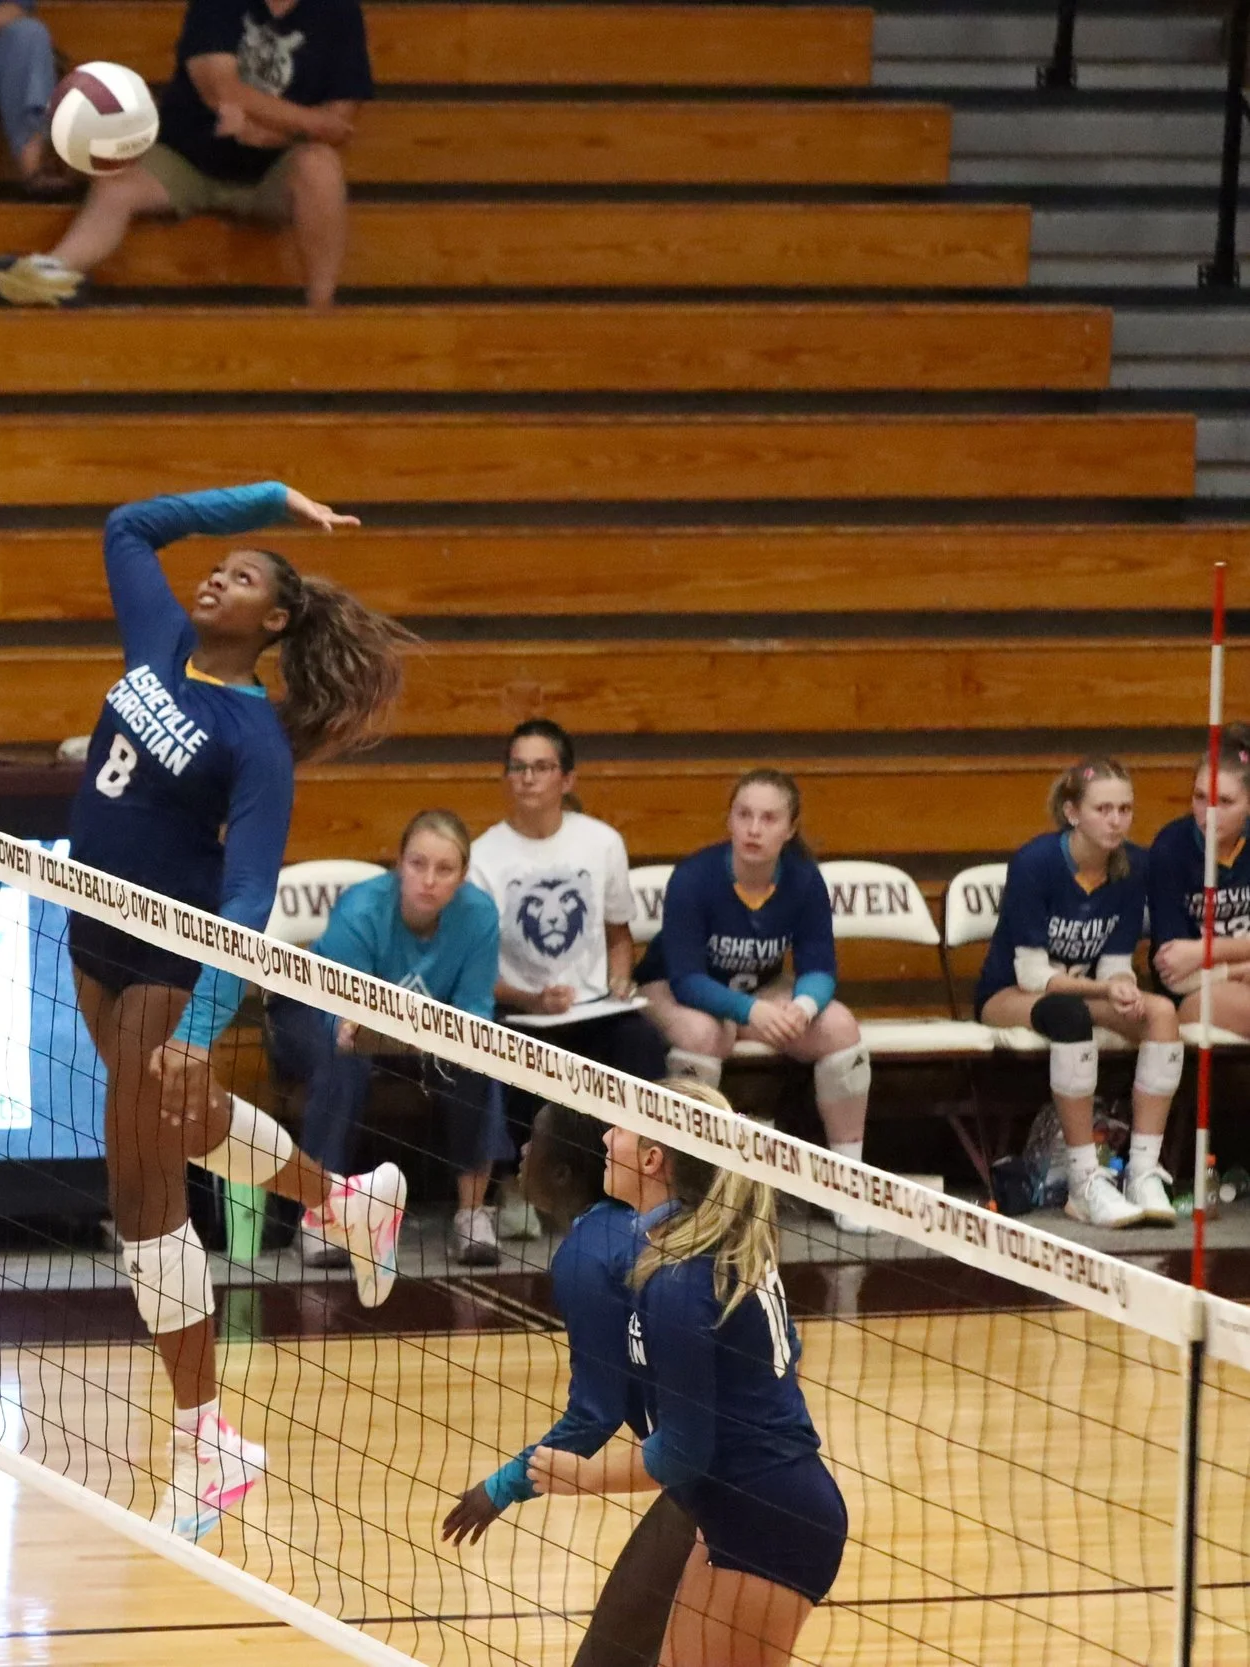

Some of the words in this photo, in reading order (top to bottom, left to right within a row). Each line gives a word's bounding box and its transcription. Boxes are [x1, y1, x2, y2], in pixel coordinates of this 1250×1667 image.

[106, 678, 192, 776] CHRISTIAN
[126, 664, 209, 754] ASHEVILLE
[96, 733, 137, 798] 8
[279, 884, 343, 917] OW
[831, 883, 912, 915] WEN
[38, 854, 115, 908] VOLLEYBALL
[131, 890, 167, 931] OWEN
[174, 908, 255, 965] VOLLEYBALL
[272, 946, 312, 986] OWEN
[318, 964, 404, 1021] VOLLEYBALL
[421, 1002, 464, 1043] OWEN
[470, 1020, 562, 1081] VOLLEYBALL
[582, 1064, 626, 1108] OWEN
[634, 1083, 732, 1149] VOLLEYBALL
[754, 1131, 801, 1176] OWEN
[809, 1152, 912, 1219] VOLLEYBALL
[936, 1201, 987, 1249] OWEN
[996, 1223, 1109, 1295] VOLLEYBALL
